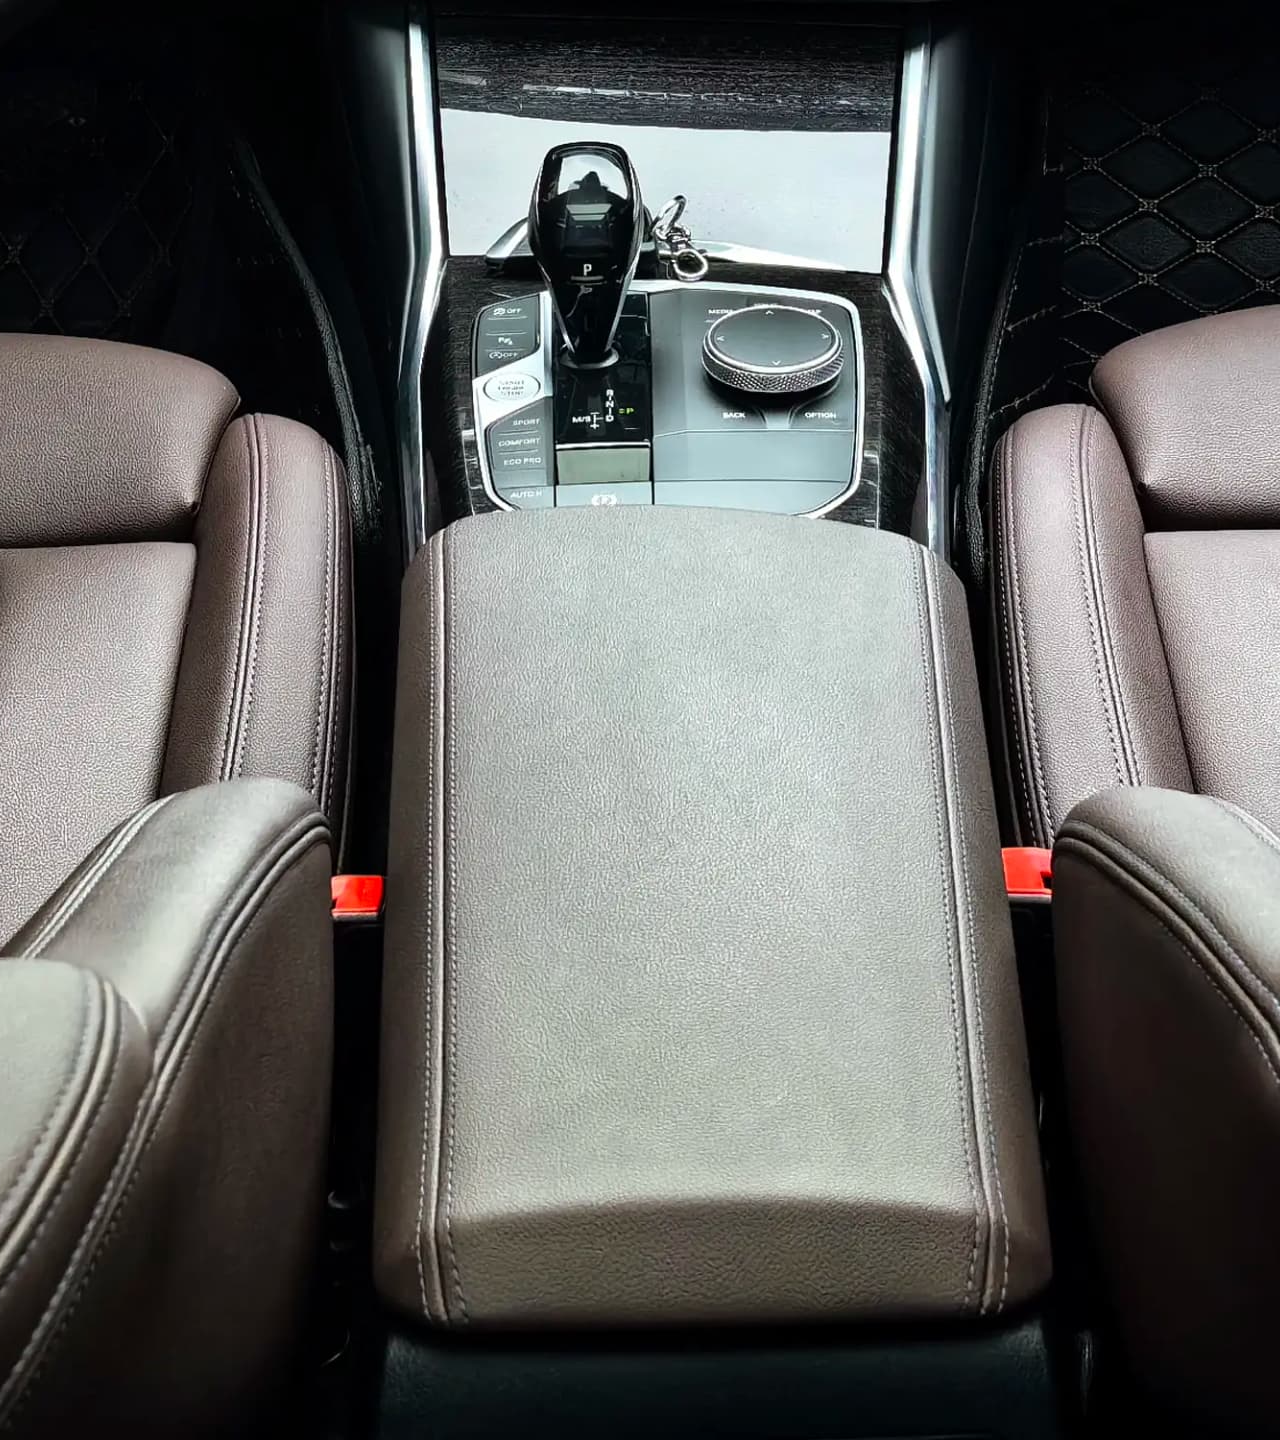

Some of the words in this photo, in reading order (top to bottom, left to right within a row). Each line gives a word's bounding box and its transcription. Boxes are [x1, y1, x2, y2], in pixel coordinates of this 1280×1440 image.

[583, 263, 592, 275] P
[512, 418, 540, 426] SPORT
[498, 437, 541, 447] COMFORT
[503, 458, 522, 466] ECO
[523, 457, 542, 465] PRO
